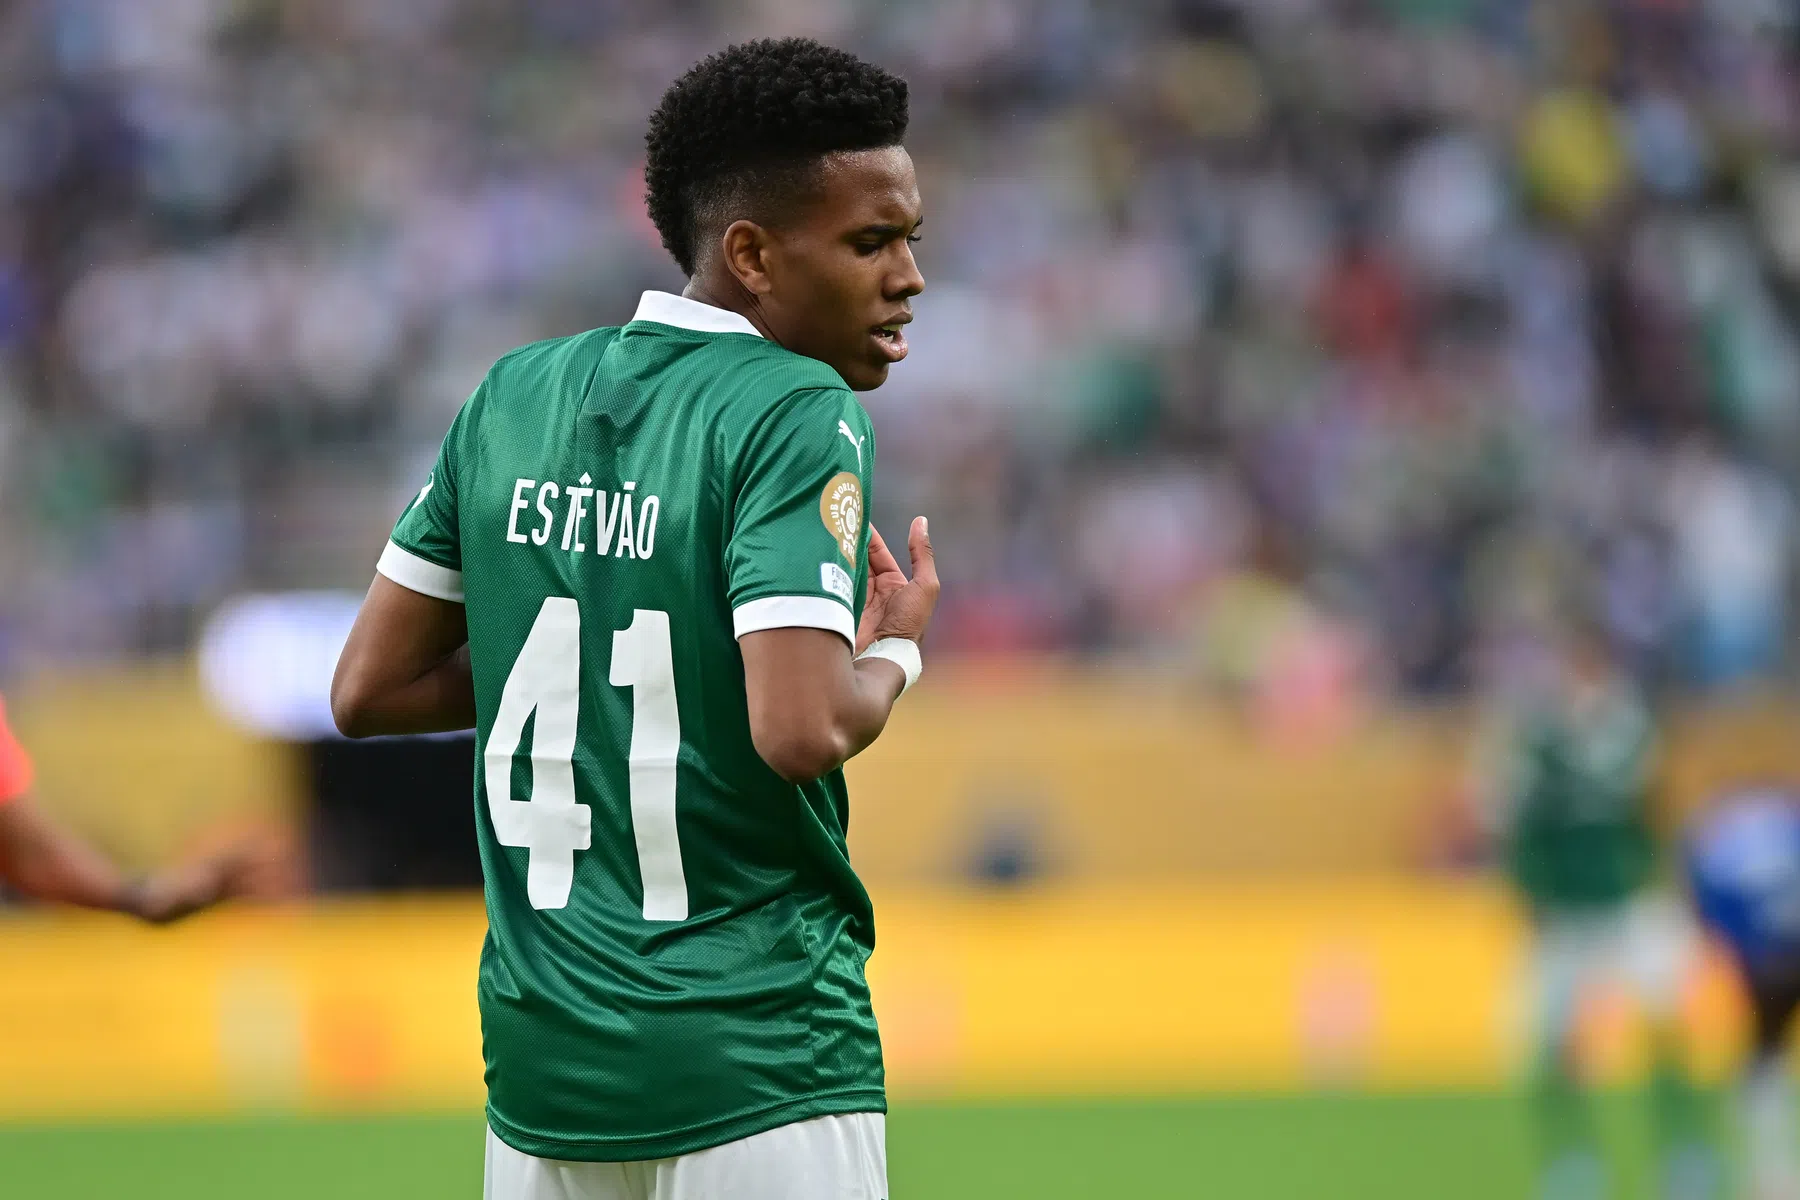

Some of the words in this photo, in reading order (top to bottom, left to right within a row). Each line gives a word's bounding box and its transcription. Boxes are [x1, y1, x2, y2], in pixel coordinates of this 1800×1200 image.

[506, 471, 660, 560] ESTÊVÃO
[830, 503, 843, 534] CLUB
[831, 482, 856, 501] WORLD
[484, 596, 689, 922] 41
